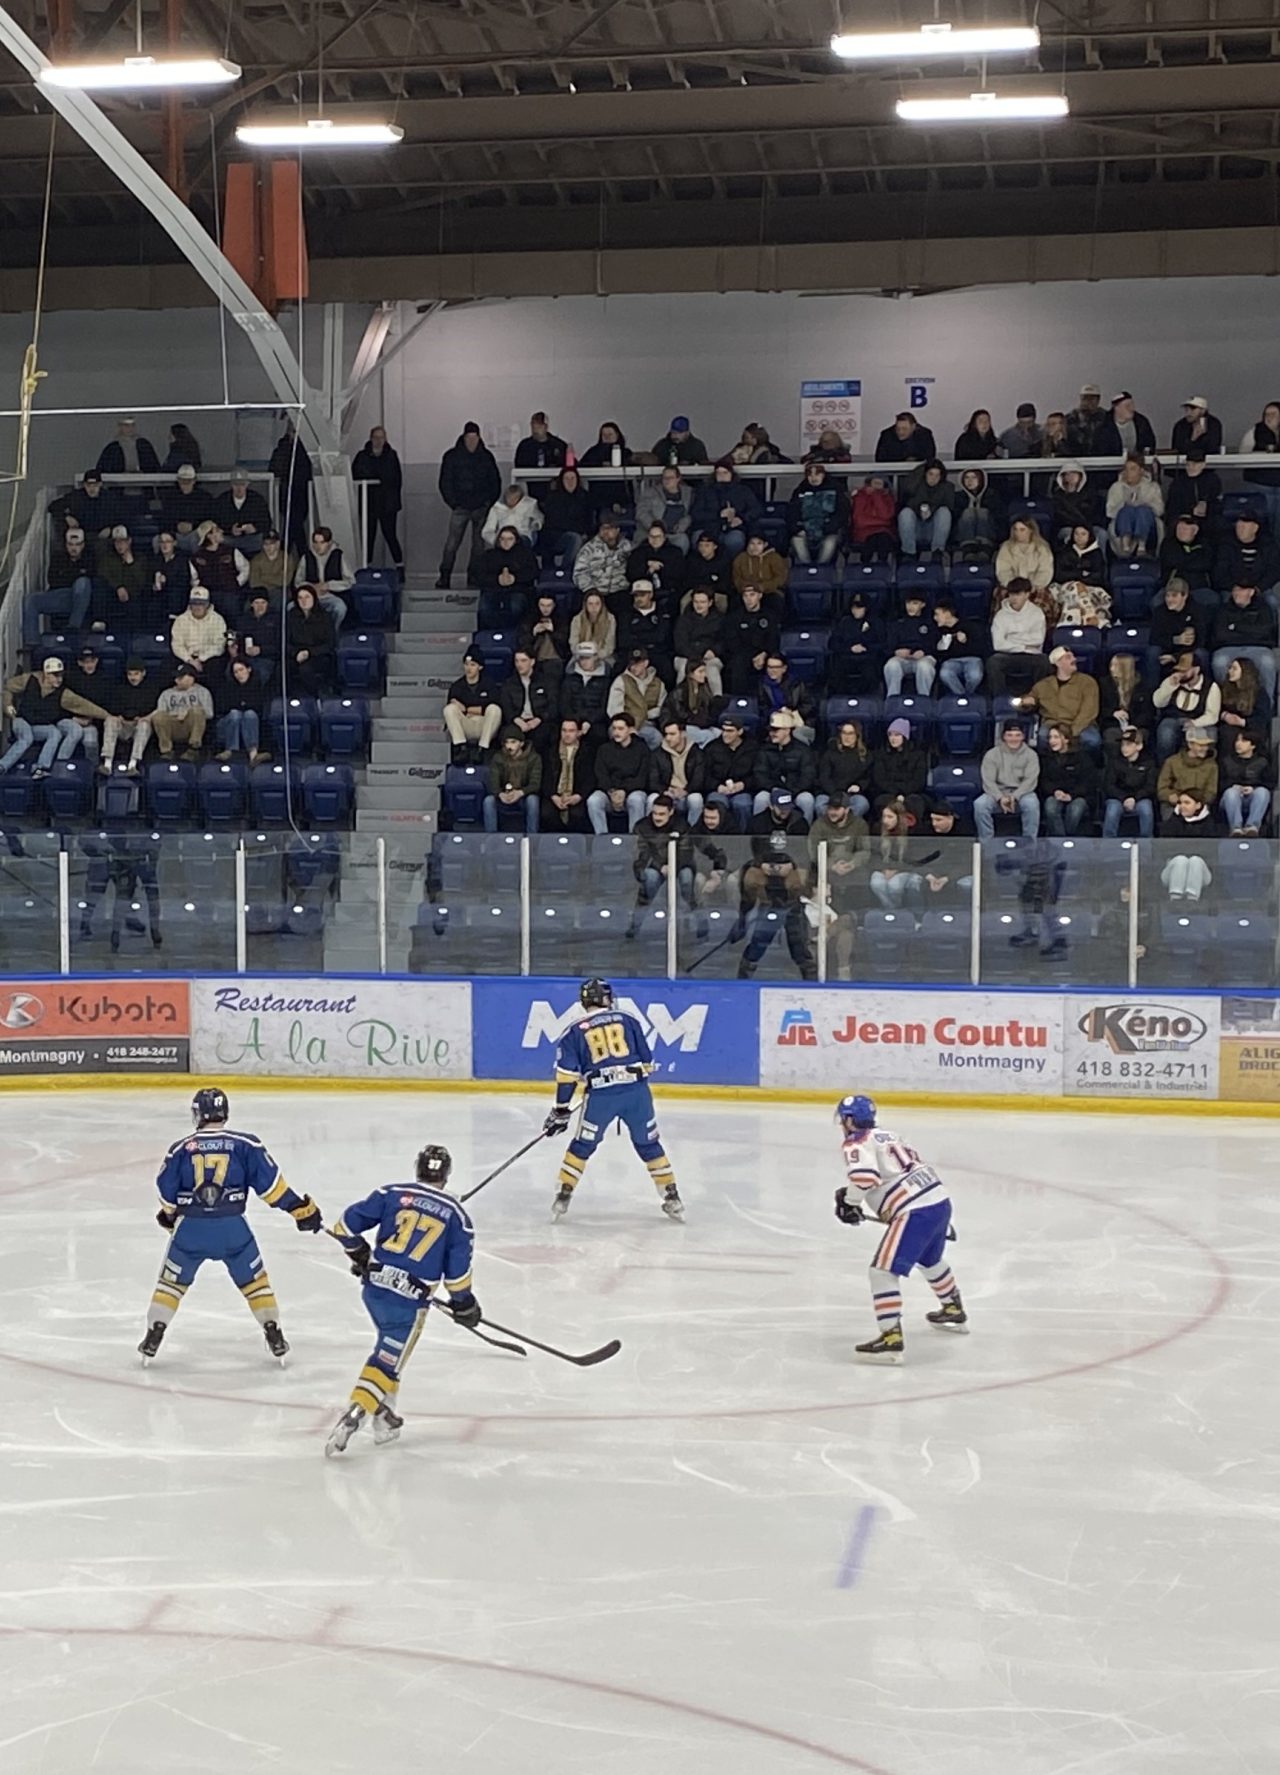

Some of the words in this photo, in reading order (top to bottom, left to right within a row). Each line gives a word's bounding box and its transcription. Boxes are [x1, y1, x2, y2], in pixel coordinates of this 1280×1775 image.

[911, 386, 928, 408] B
[58, 995, 177, 1023] Kubota
[214, 987, 357, 1013] Restaurant
[215, 1016, 267, 1065] A
[287, 1020, 328, 1064] la
[346, 1018, 451, 1067] Rive
[584, 1022, 630, 1065] 88
[832, 1016, 926, 1046] Jean
[934, 1017, 1048, 1048] Coutu
[1087, 1006, 1193, 1056] Kéno
[0, 1049, 85, 1065] Montmagny
[938, 1052, 1047, 1073] Montmagny
[1076, 1061, 1112, 1076] 418
[1119, 1062, 1209, 1078] 832-4711
[1076, 1079, 1140, 1090] Commercial
[1156, 1080, 1208, 1092] Industriel
[191, 1153, 230, 1190] 17
[381, 1208, 447, 1263] 37
